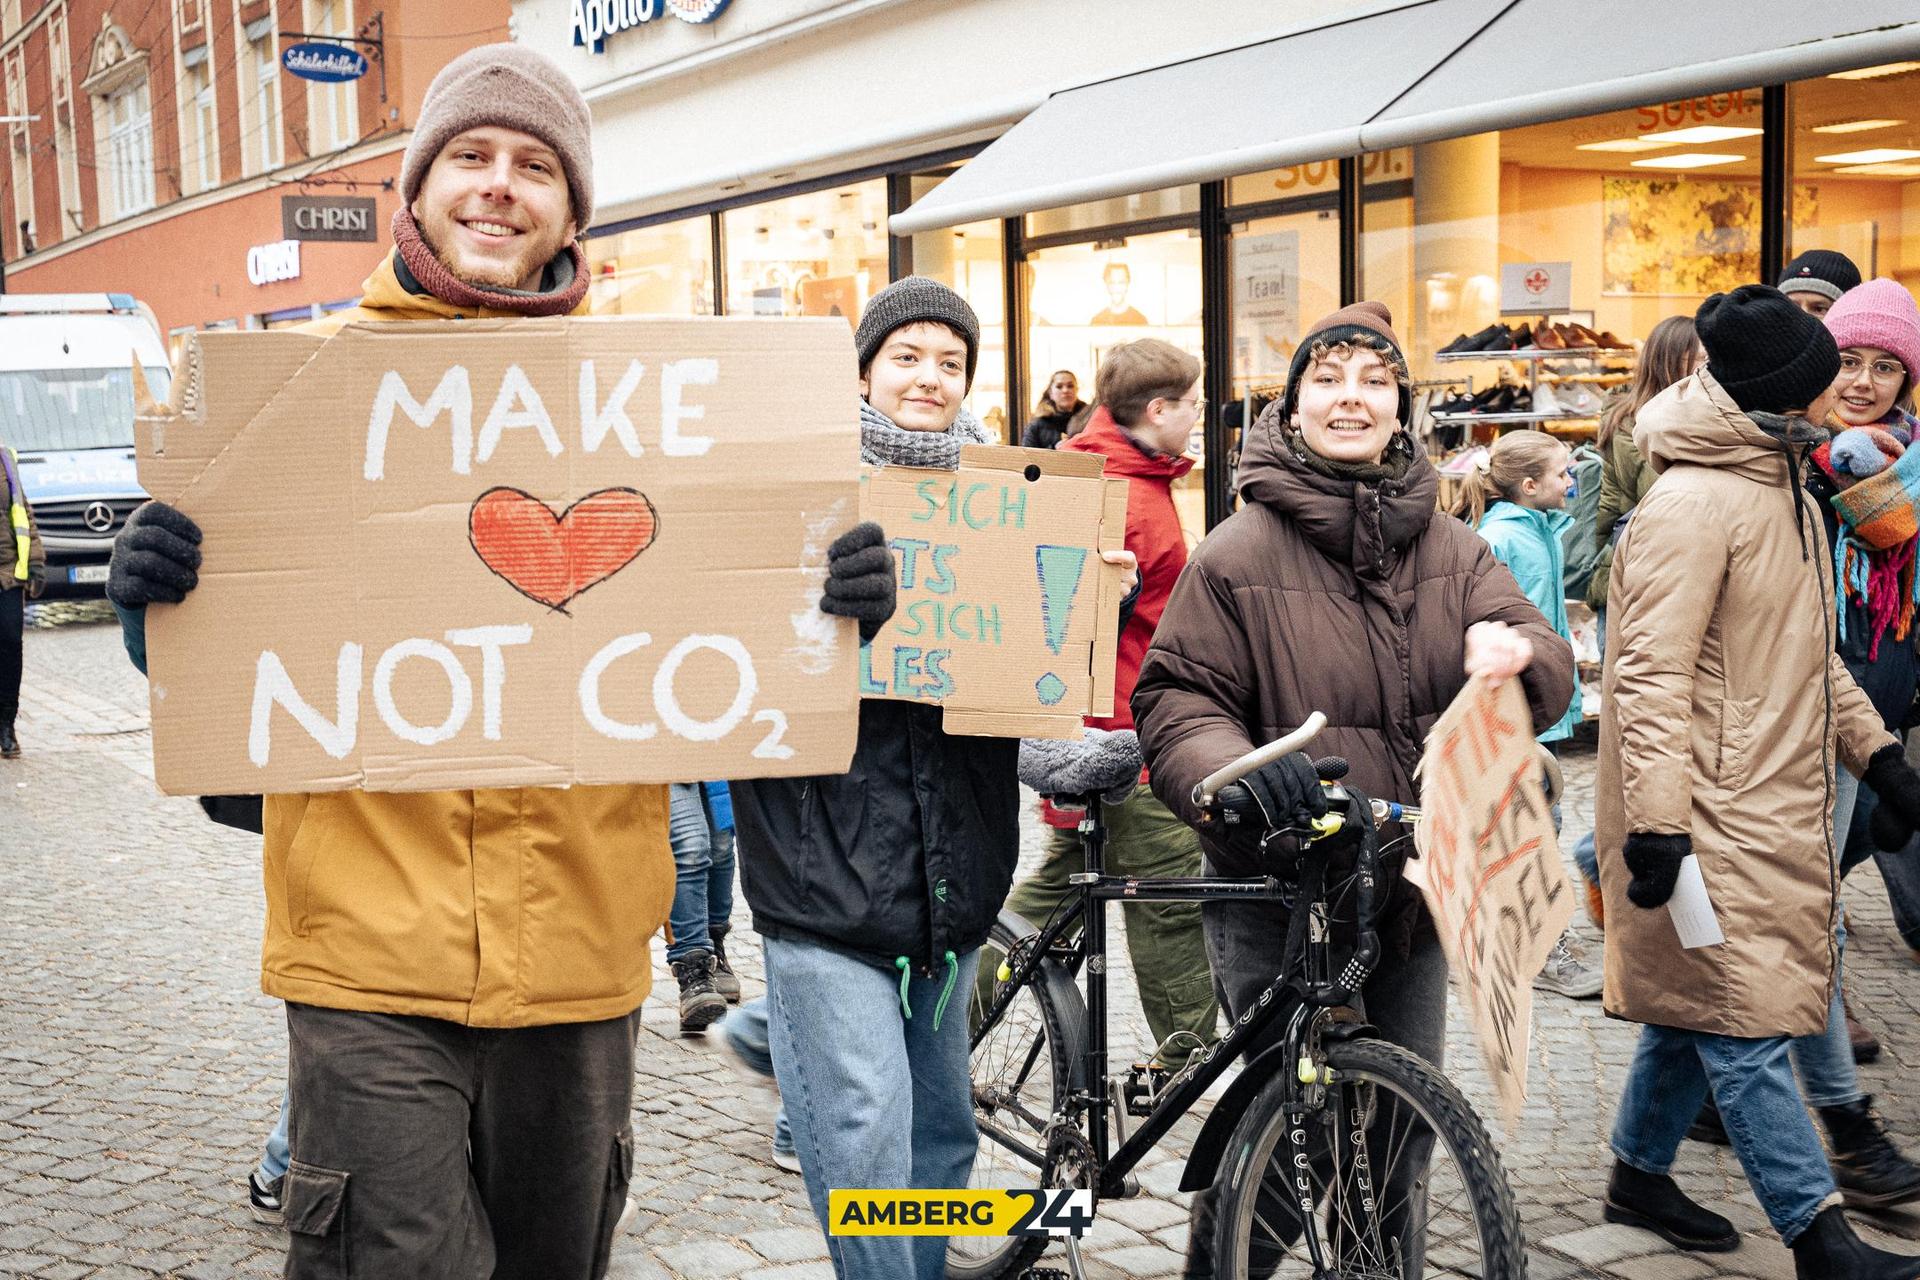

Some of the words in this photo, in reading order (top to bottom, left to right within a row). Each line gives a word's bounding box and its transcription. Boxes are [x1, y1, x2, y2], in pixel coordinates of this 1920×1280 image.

[294, 206, 369, 231] CHRIST
[363, 357, 720, 480] MAKE
[911, 479, 1028, 530] SICH
[895, 599, 1003, 645] SICH
[248, 623, 533, 767] NOT
